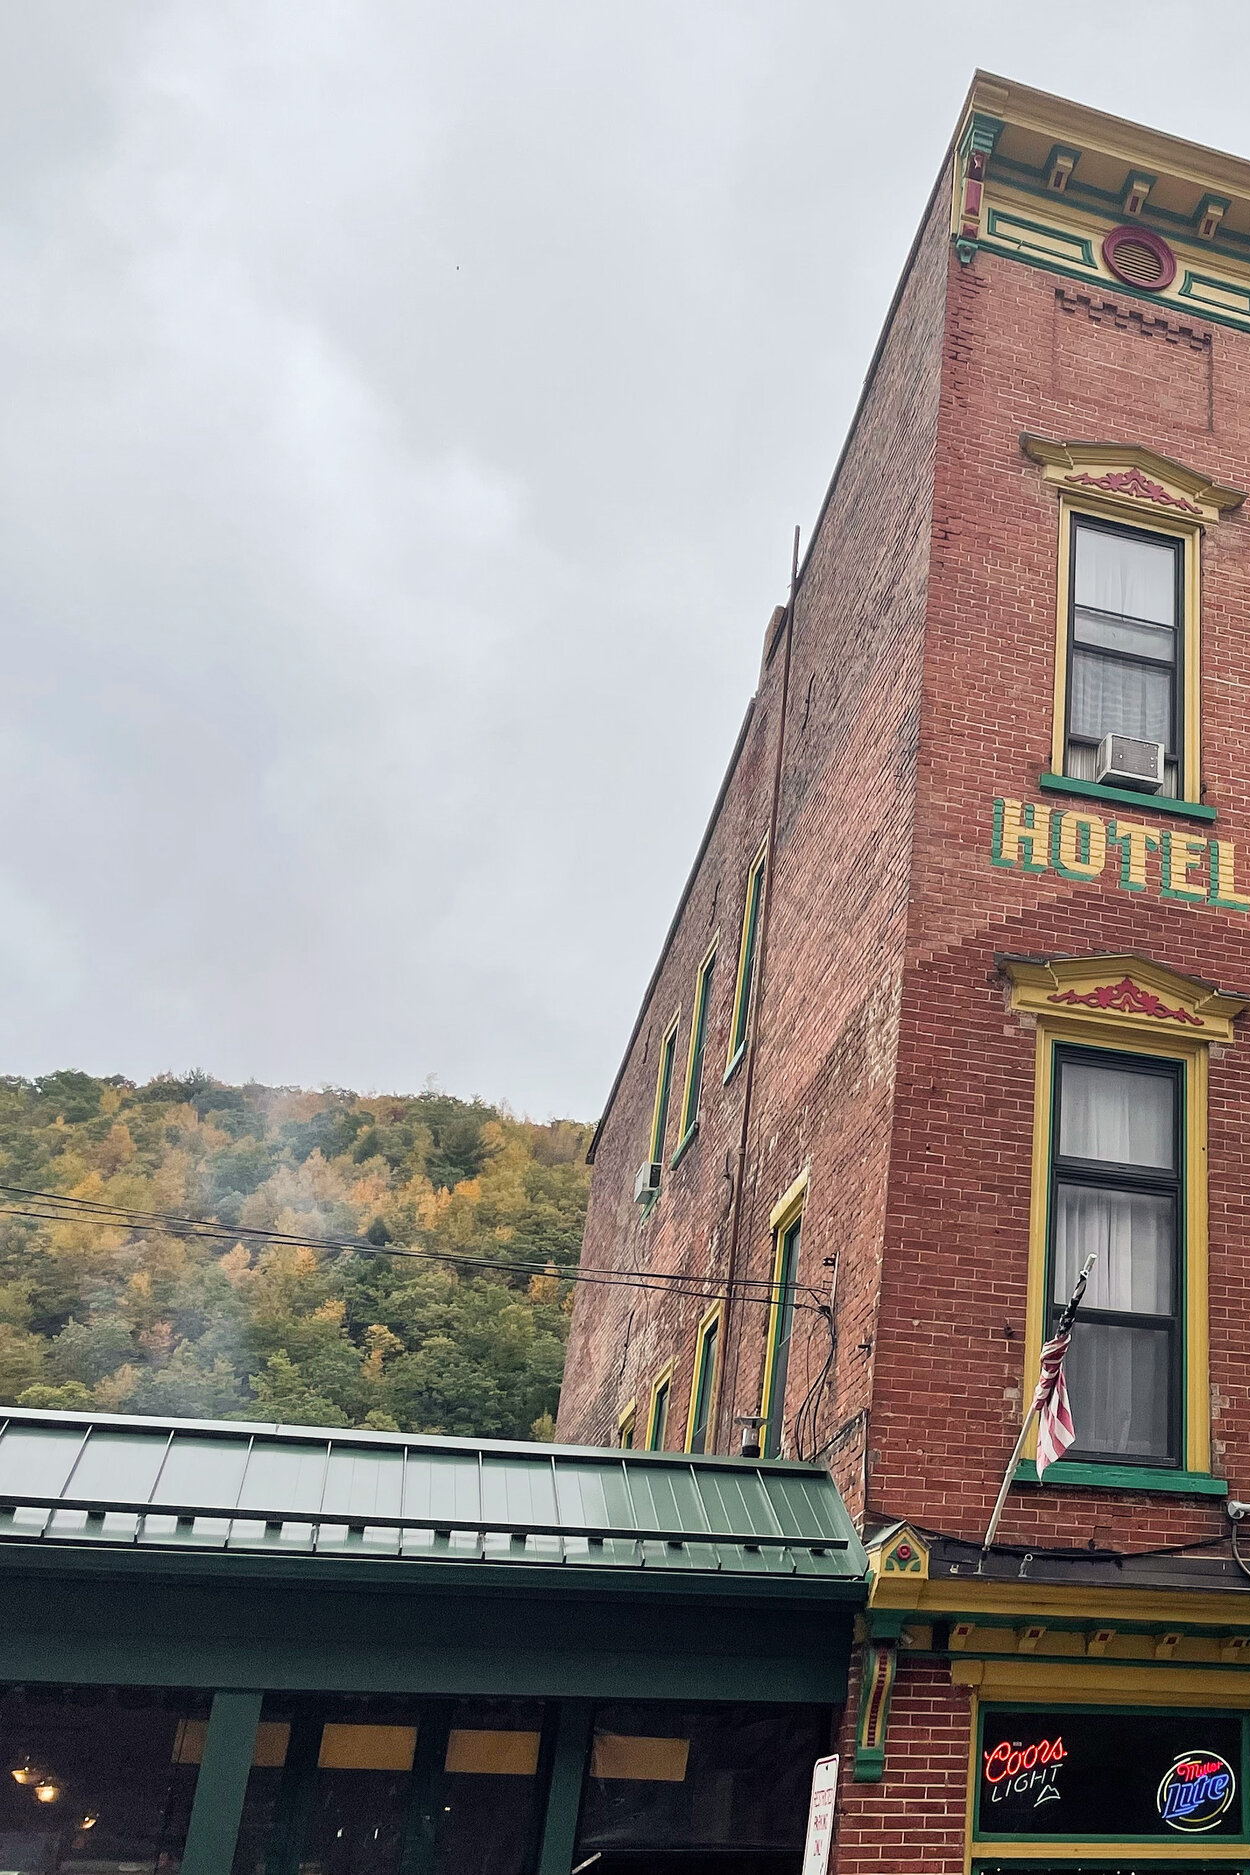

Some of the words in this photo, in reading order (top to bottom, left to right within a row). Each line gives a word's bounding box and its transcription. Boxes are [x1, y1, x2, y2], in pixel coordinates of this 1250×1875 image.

[984, 1736, 1068, 1783] Coors
[1176, 1761, 1224, 1782] Miller
[991, 1764, 1063, 1802] LIGHT
[1162, 1773, 1229, 1819] Lite
